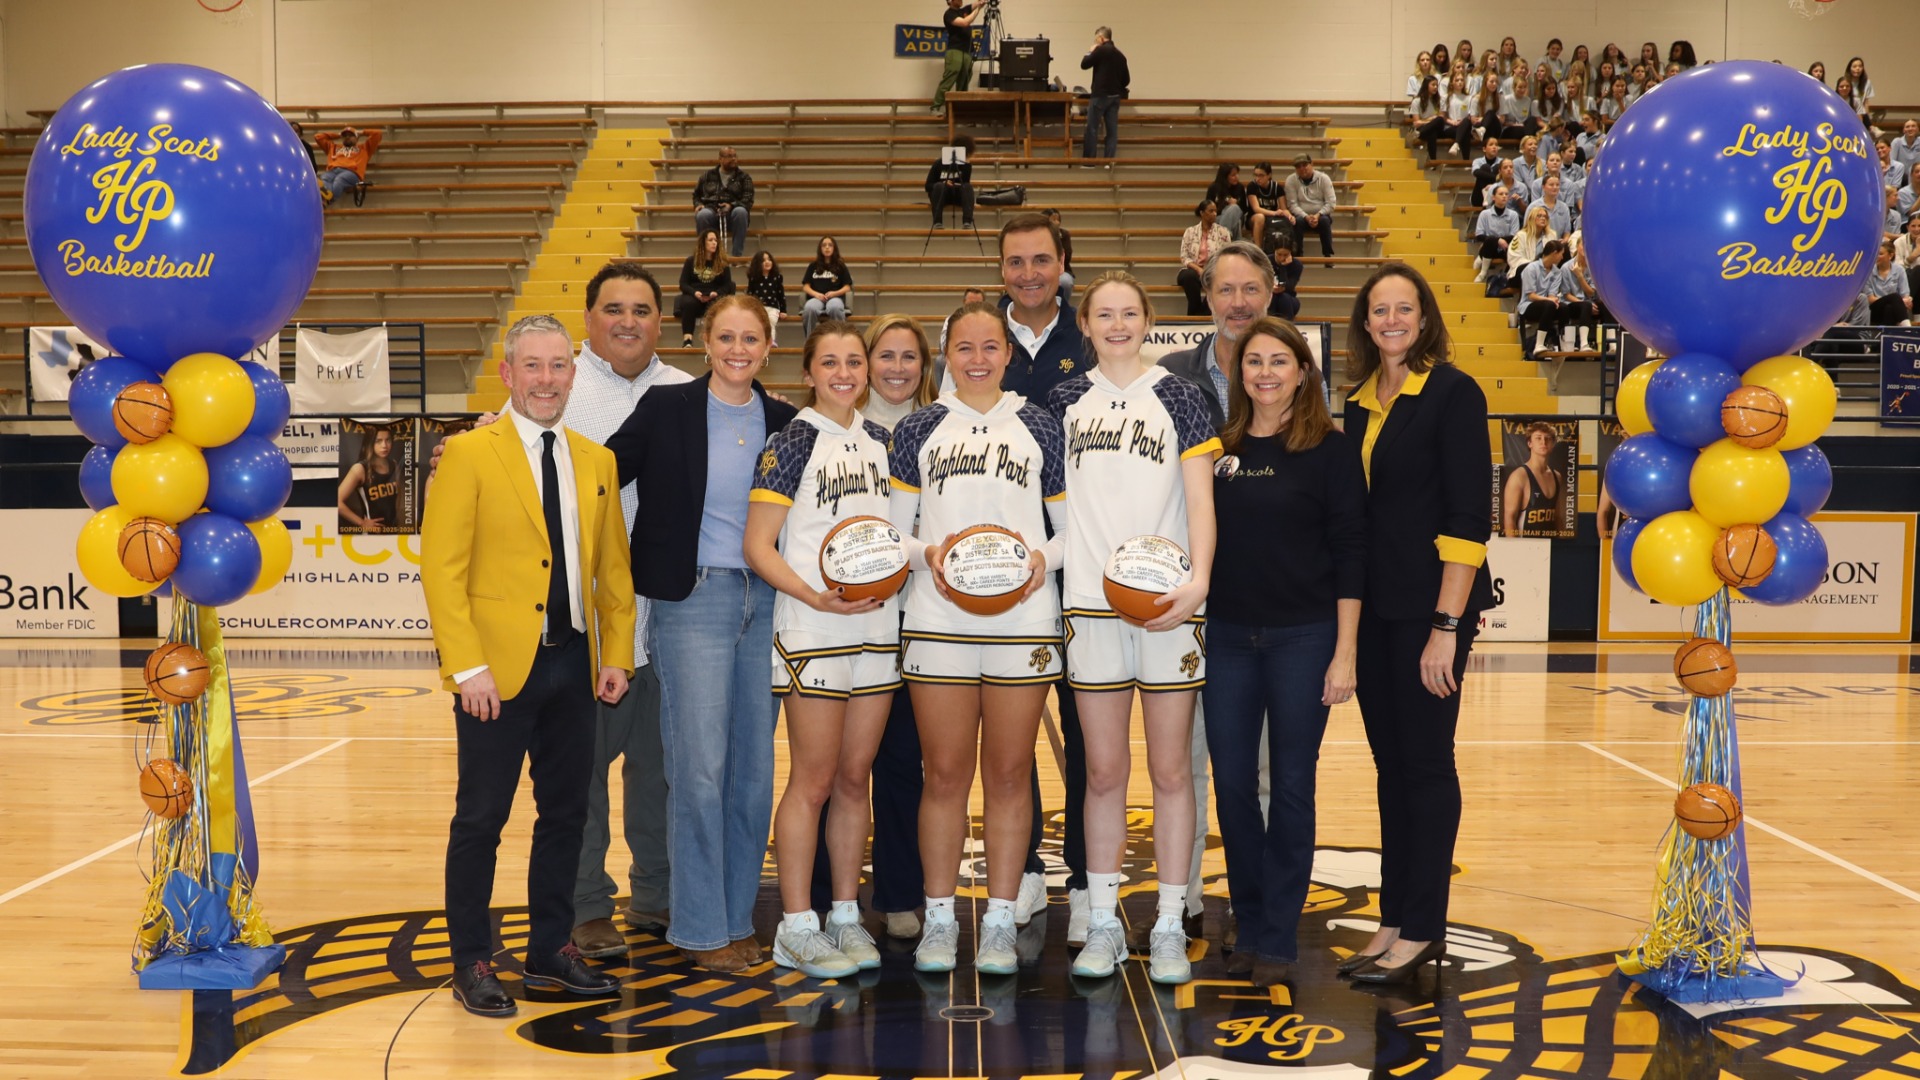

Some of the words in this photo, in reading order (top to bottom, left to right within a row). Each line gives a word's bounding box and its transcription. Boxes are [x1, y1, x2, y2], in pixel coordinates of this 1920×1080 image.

[903, 28, 983, 39] VISIR
[904, 41, 982, 53] ADUS
[61, 123, 138, 158] Lady
[136, 124, 219, 161] Scots
[1722, 123, 1809, 158] Lady
[1812, 122, 1867, 159] Scots
[85, 156, 175, 252] HP
[1765, 156, 1847, 252] HP
[57, 239, 215, 279] Basketball
[1717, 242, 1863, 280] Basketball
[1143, 332, 1177, 345] ANK
[1059, 358, 1075, 373] HP
[282, 424, 315, 439] ELL,
[341, 418, 415, 434] VATY
[1503, 421, 1578, 435] VATY
[280, 445, 319, 454] THOPEDIC
[404, 441, 412, 476] FLORES
[1069, 418, 1127, 470] Highland
[1129, 419, 1165, 465] Park
[928, 443, 990, 495] Highland
[995, 443, 1030, 489] Park
[1492, 464, 1500, 494] GREEN
[1566, 446, 1576, 493] MCCLAIN
[404, 479, 412, 524] DANIELLA
[816, 460, 868, 516] Highland
[868, 461, 890, 498] Pa
[1492, 497, 1500, 524] LAIRD
[1566, 495, 1575, 529] RYDER
[841, 555, 854, 564] LADY
[854, 549, 872, 559] SCOTS
[871, 544, 901, 554] BASKETBALL
[965, 549, 991, 558] DISTRICT
[1152, 557, 1184, 577] BASKETBALL
[0, 572, 90, 610] Bank
[283, 572, 390, 583] HIGHLAND
[398, 572, 421, 583] PA
[1804, 594, 1878, 604] NAGEMENT
[16, 619, 64, 630] Member
[67, 619, 96, 630] FDIC
[218, 617, 433, 630] SCHULERCOMPANY.CO
[1029, 645, 1052, 673] HP
[1179, 649, 1200, 679] HP
[1213, 1013, 1346, 1061] HP
